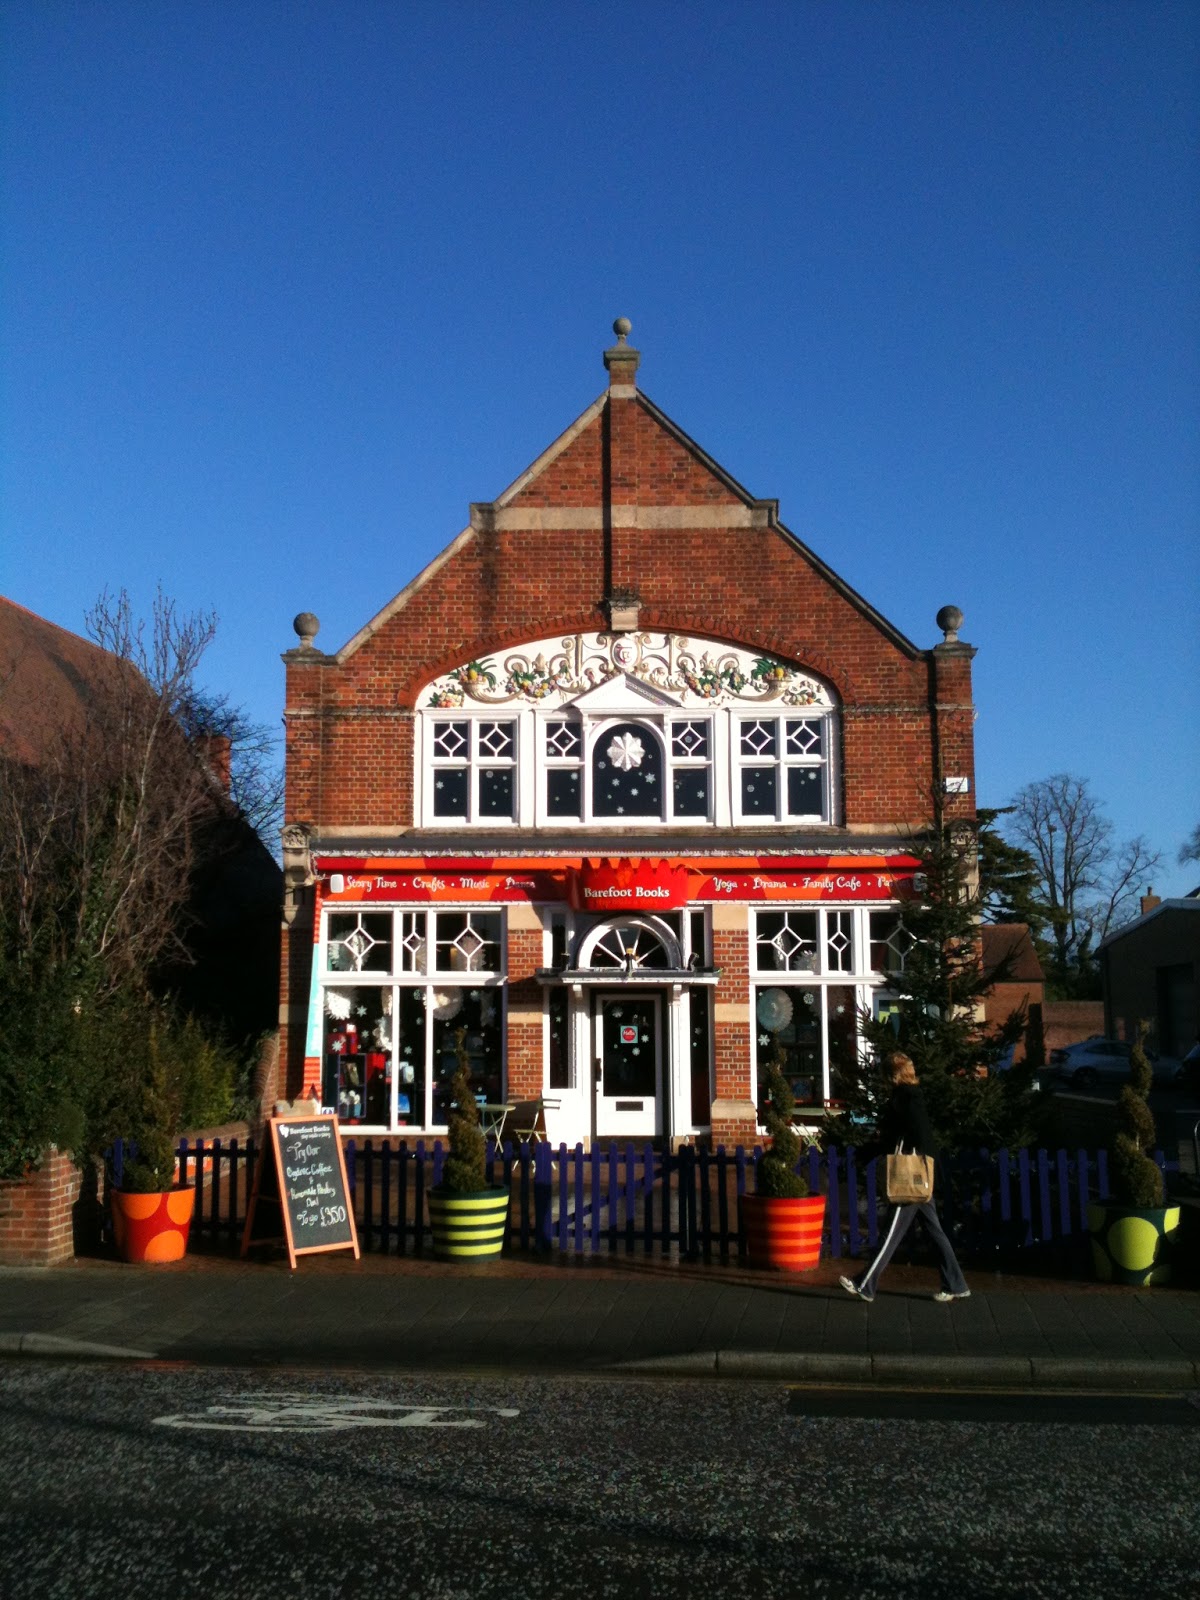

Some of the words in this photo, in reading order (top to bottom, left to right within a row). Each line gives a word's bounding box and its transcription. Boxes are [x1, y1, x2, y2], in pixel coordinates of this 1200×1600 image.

[347, 876, 372, 891] Story
[375, 876, 397, 889] Time
[412, 876, 445, 890] Crafts
[460, 876, 490, 889] Music
[713, 877, 738, 893] Yoga
[753, 877, 787, 889] Drama
[802, 877, 834, 892] Family
[837, 876, 861, 891] Cafe
[584, 886, 632, 898] Barefoot
[635, 886, 670, 898] Books
[286, 1141, 306, 1163] Try
[310, 1162, 333, 1177] Coffee
